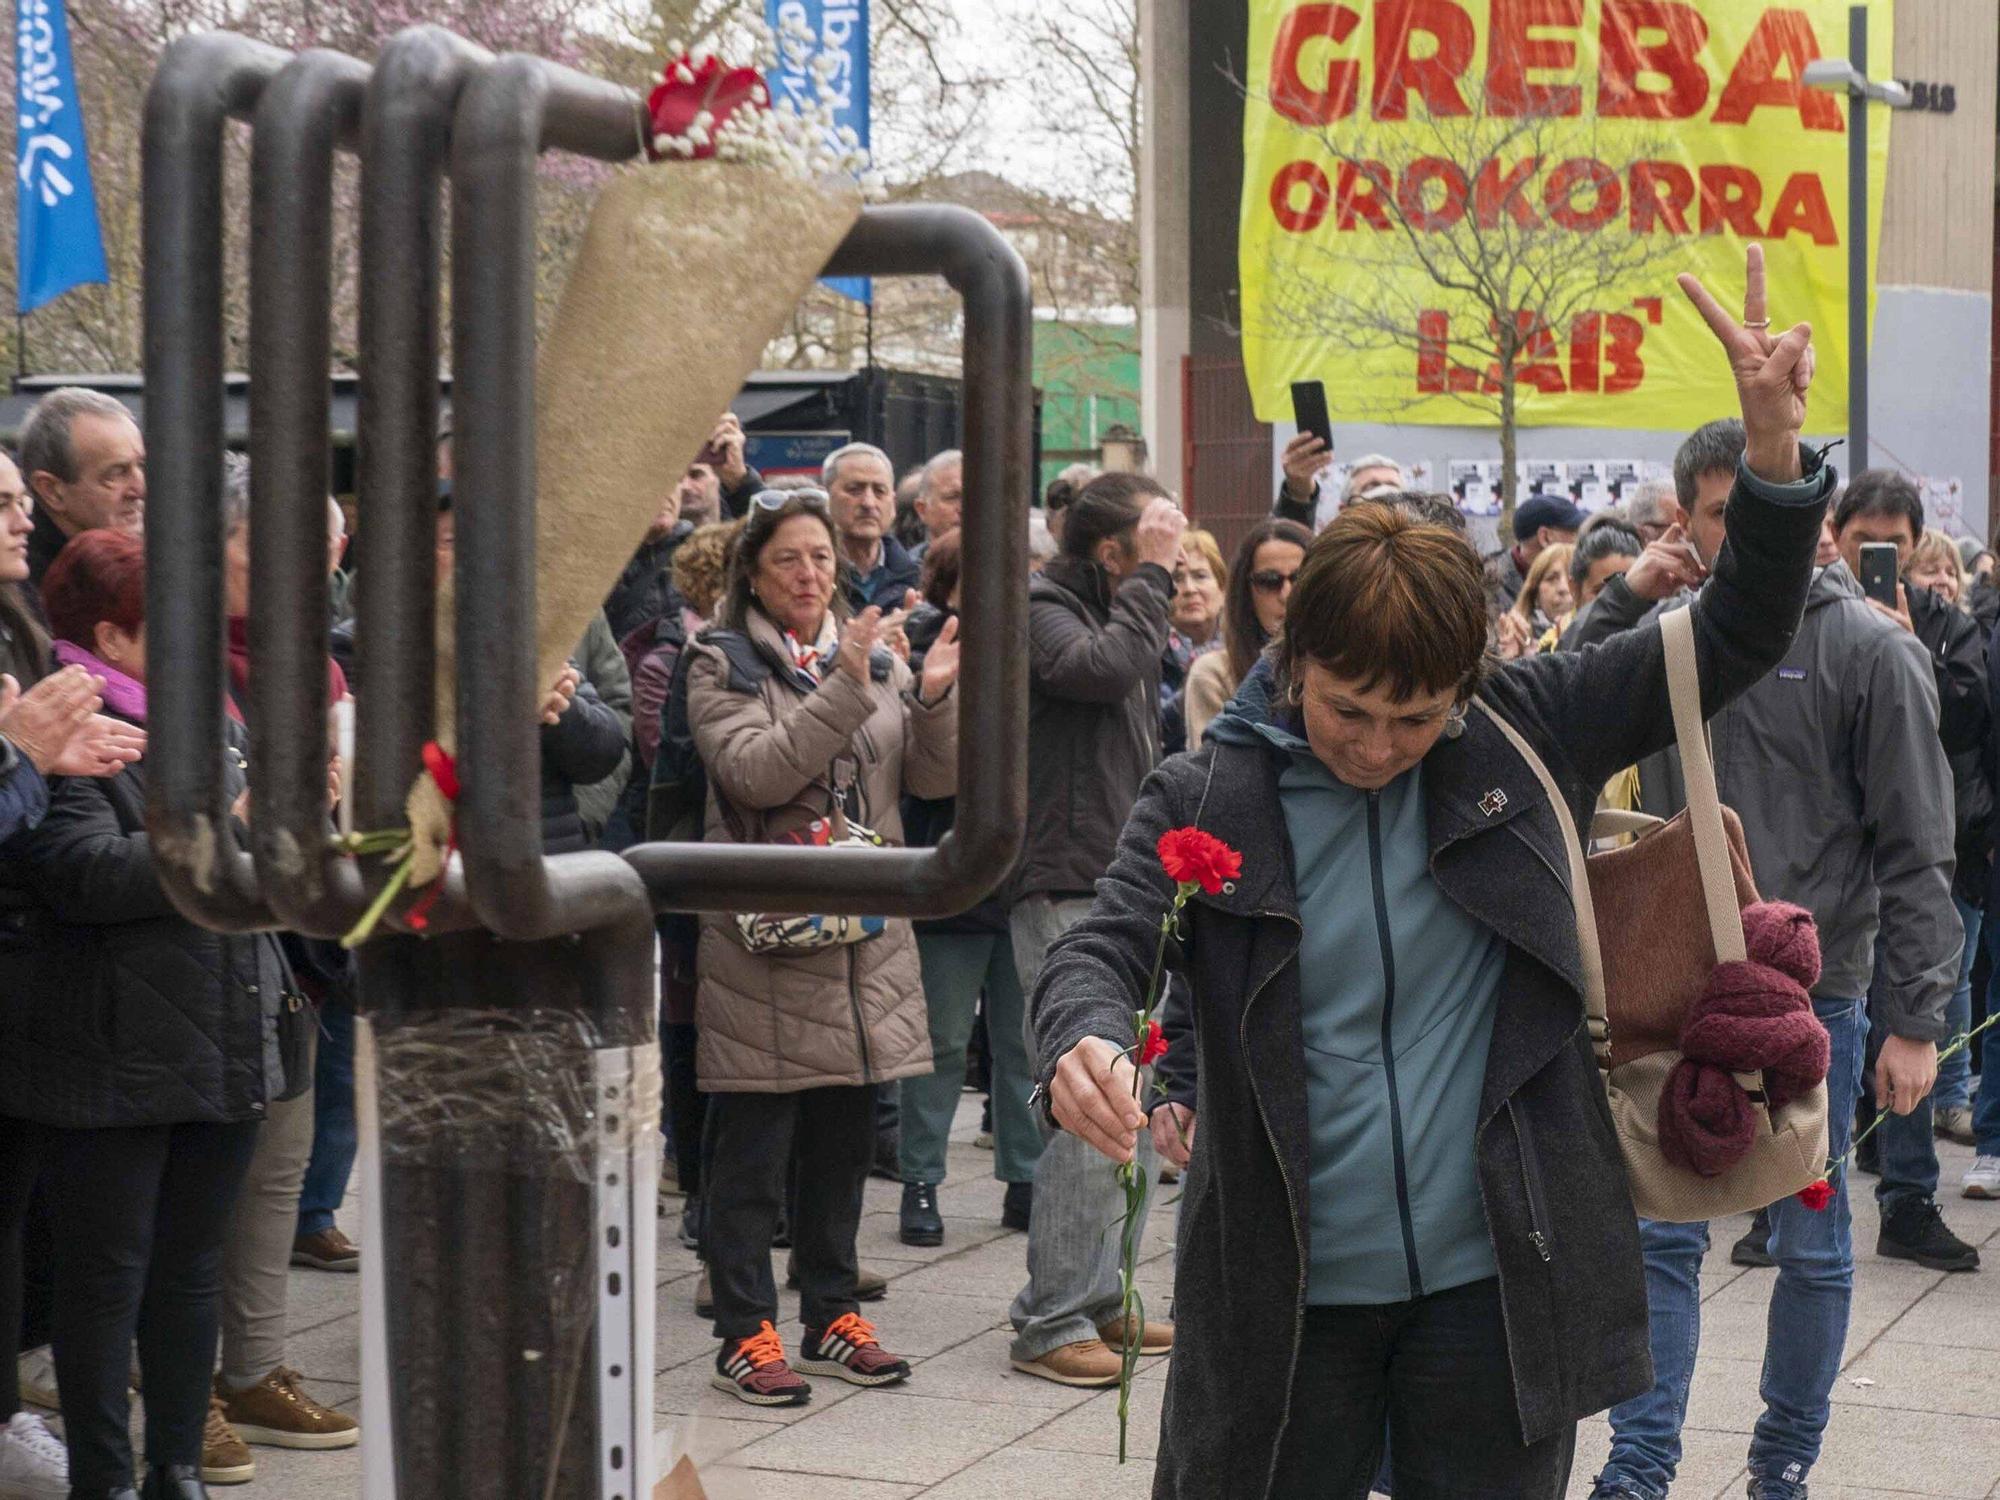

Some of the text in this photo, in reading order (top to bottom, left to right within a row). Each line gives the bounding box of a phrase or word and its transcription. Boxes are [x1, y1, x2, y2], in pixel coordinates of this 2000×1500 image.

[1270, 0, 1844, 132] GREBA
[1270, 156, 1839, 246] OROKORRA
[1417, 310, 1646, 393] LAB
